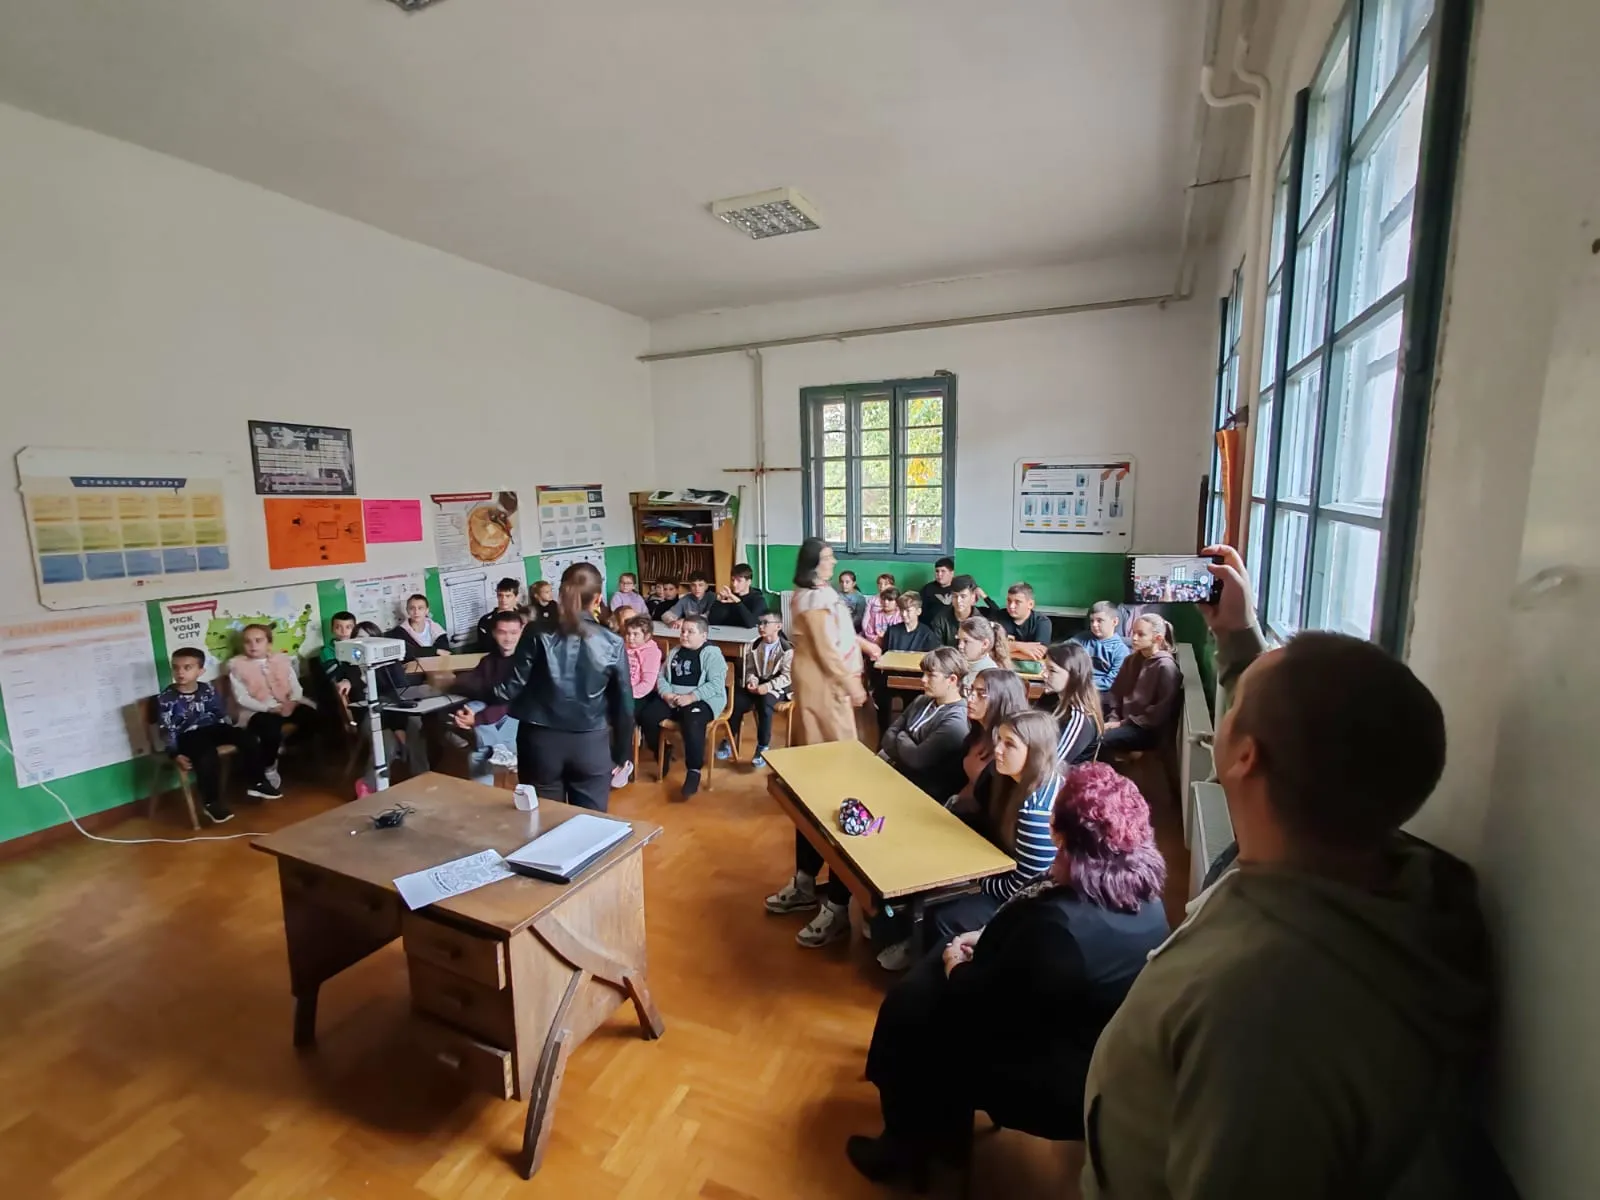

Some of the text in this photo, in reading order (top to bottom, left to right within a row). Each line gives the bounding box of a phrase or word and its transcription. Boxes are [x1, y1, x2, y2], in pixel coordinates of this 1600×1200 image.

[169, 615, 194, 625] PICK
[173, 622, 201, 633] YOUR
[178, 630, 201, 640] CITY
